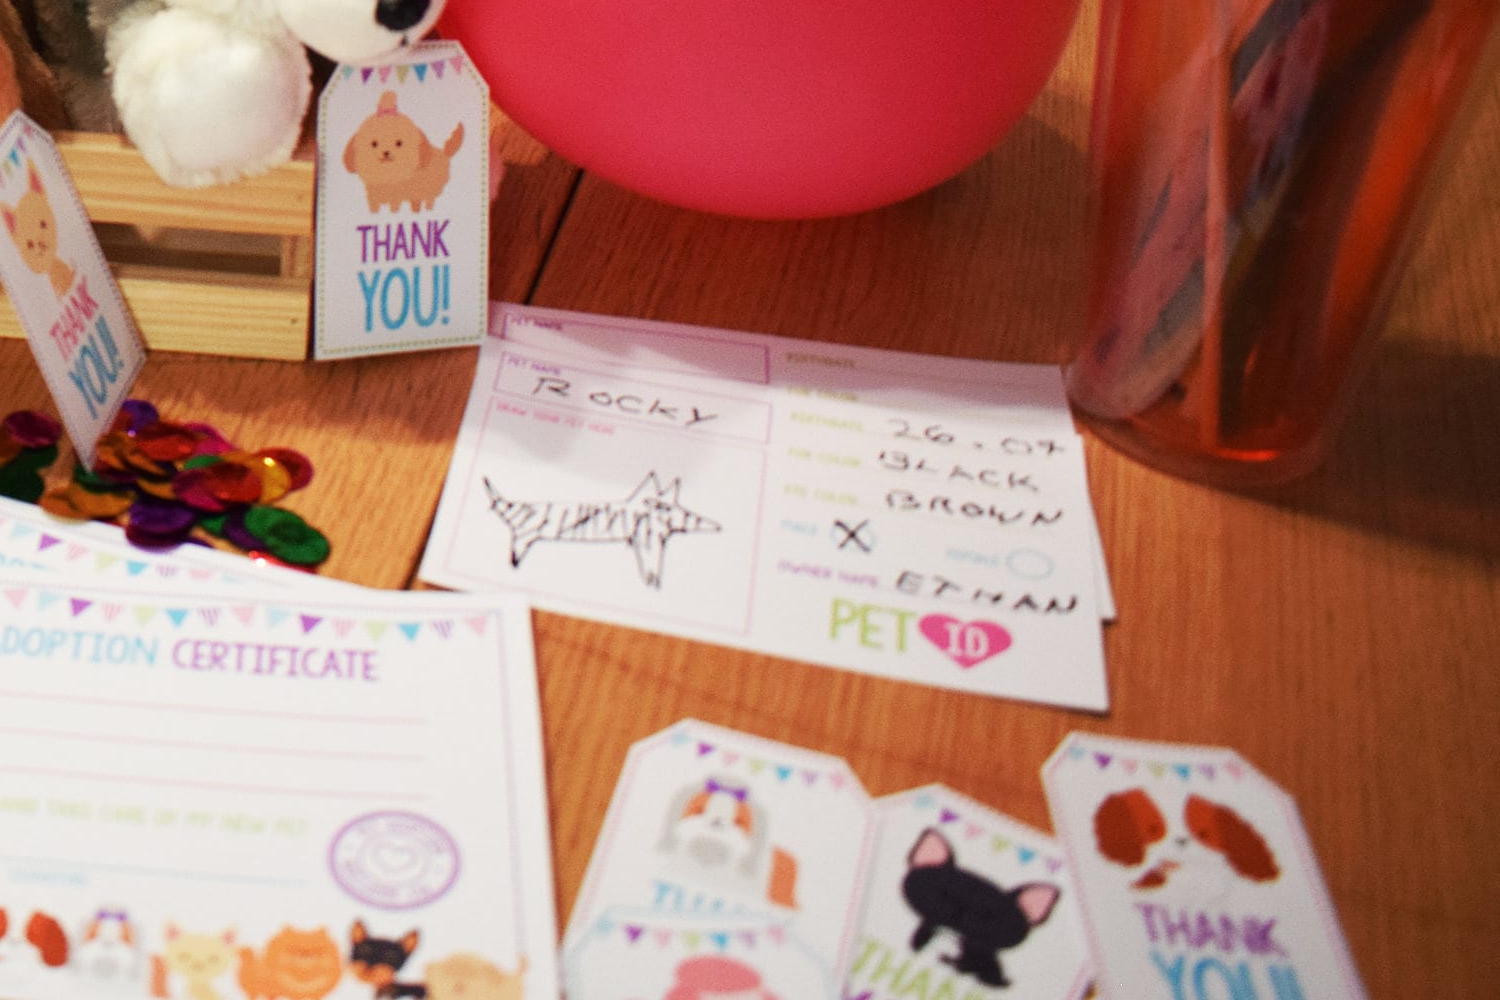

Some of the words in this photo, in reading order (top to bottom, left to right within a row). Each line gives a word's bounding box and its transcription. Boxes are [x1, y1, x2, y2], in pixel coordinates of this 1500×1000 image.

[357, 219, 451, 264] THANK
[49, 274, 99, 363] THANK
[358, 264, 452, 332] YOU!
[68, 315, 125, 420] YOU!
[532, 377, 719, 427] ROCKY
[879, 450, 1040, 494] BLACK
[886, 489, 1065, 527] BROWN
[896, 570, 1079, 616] ETHAN
[829, 598, 916, 654] PET
[945, 620, 990, 660] ID
[172, 637, 380, 682] CERTIFICATE
[1133, 903, 1290, 958] THANK
